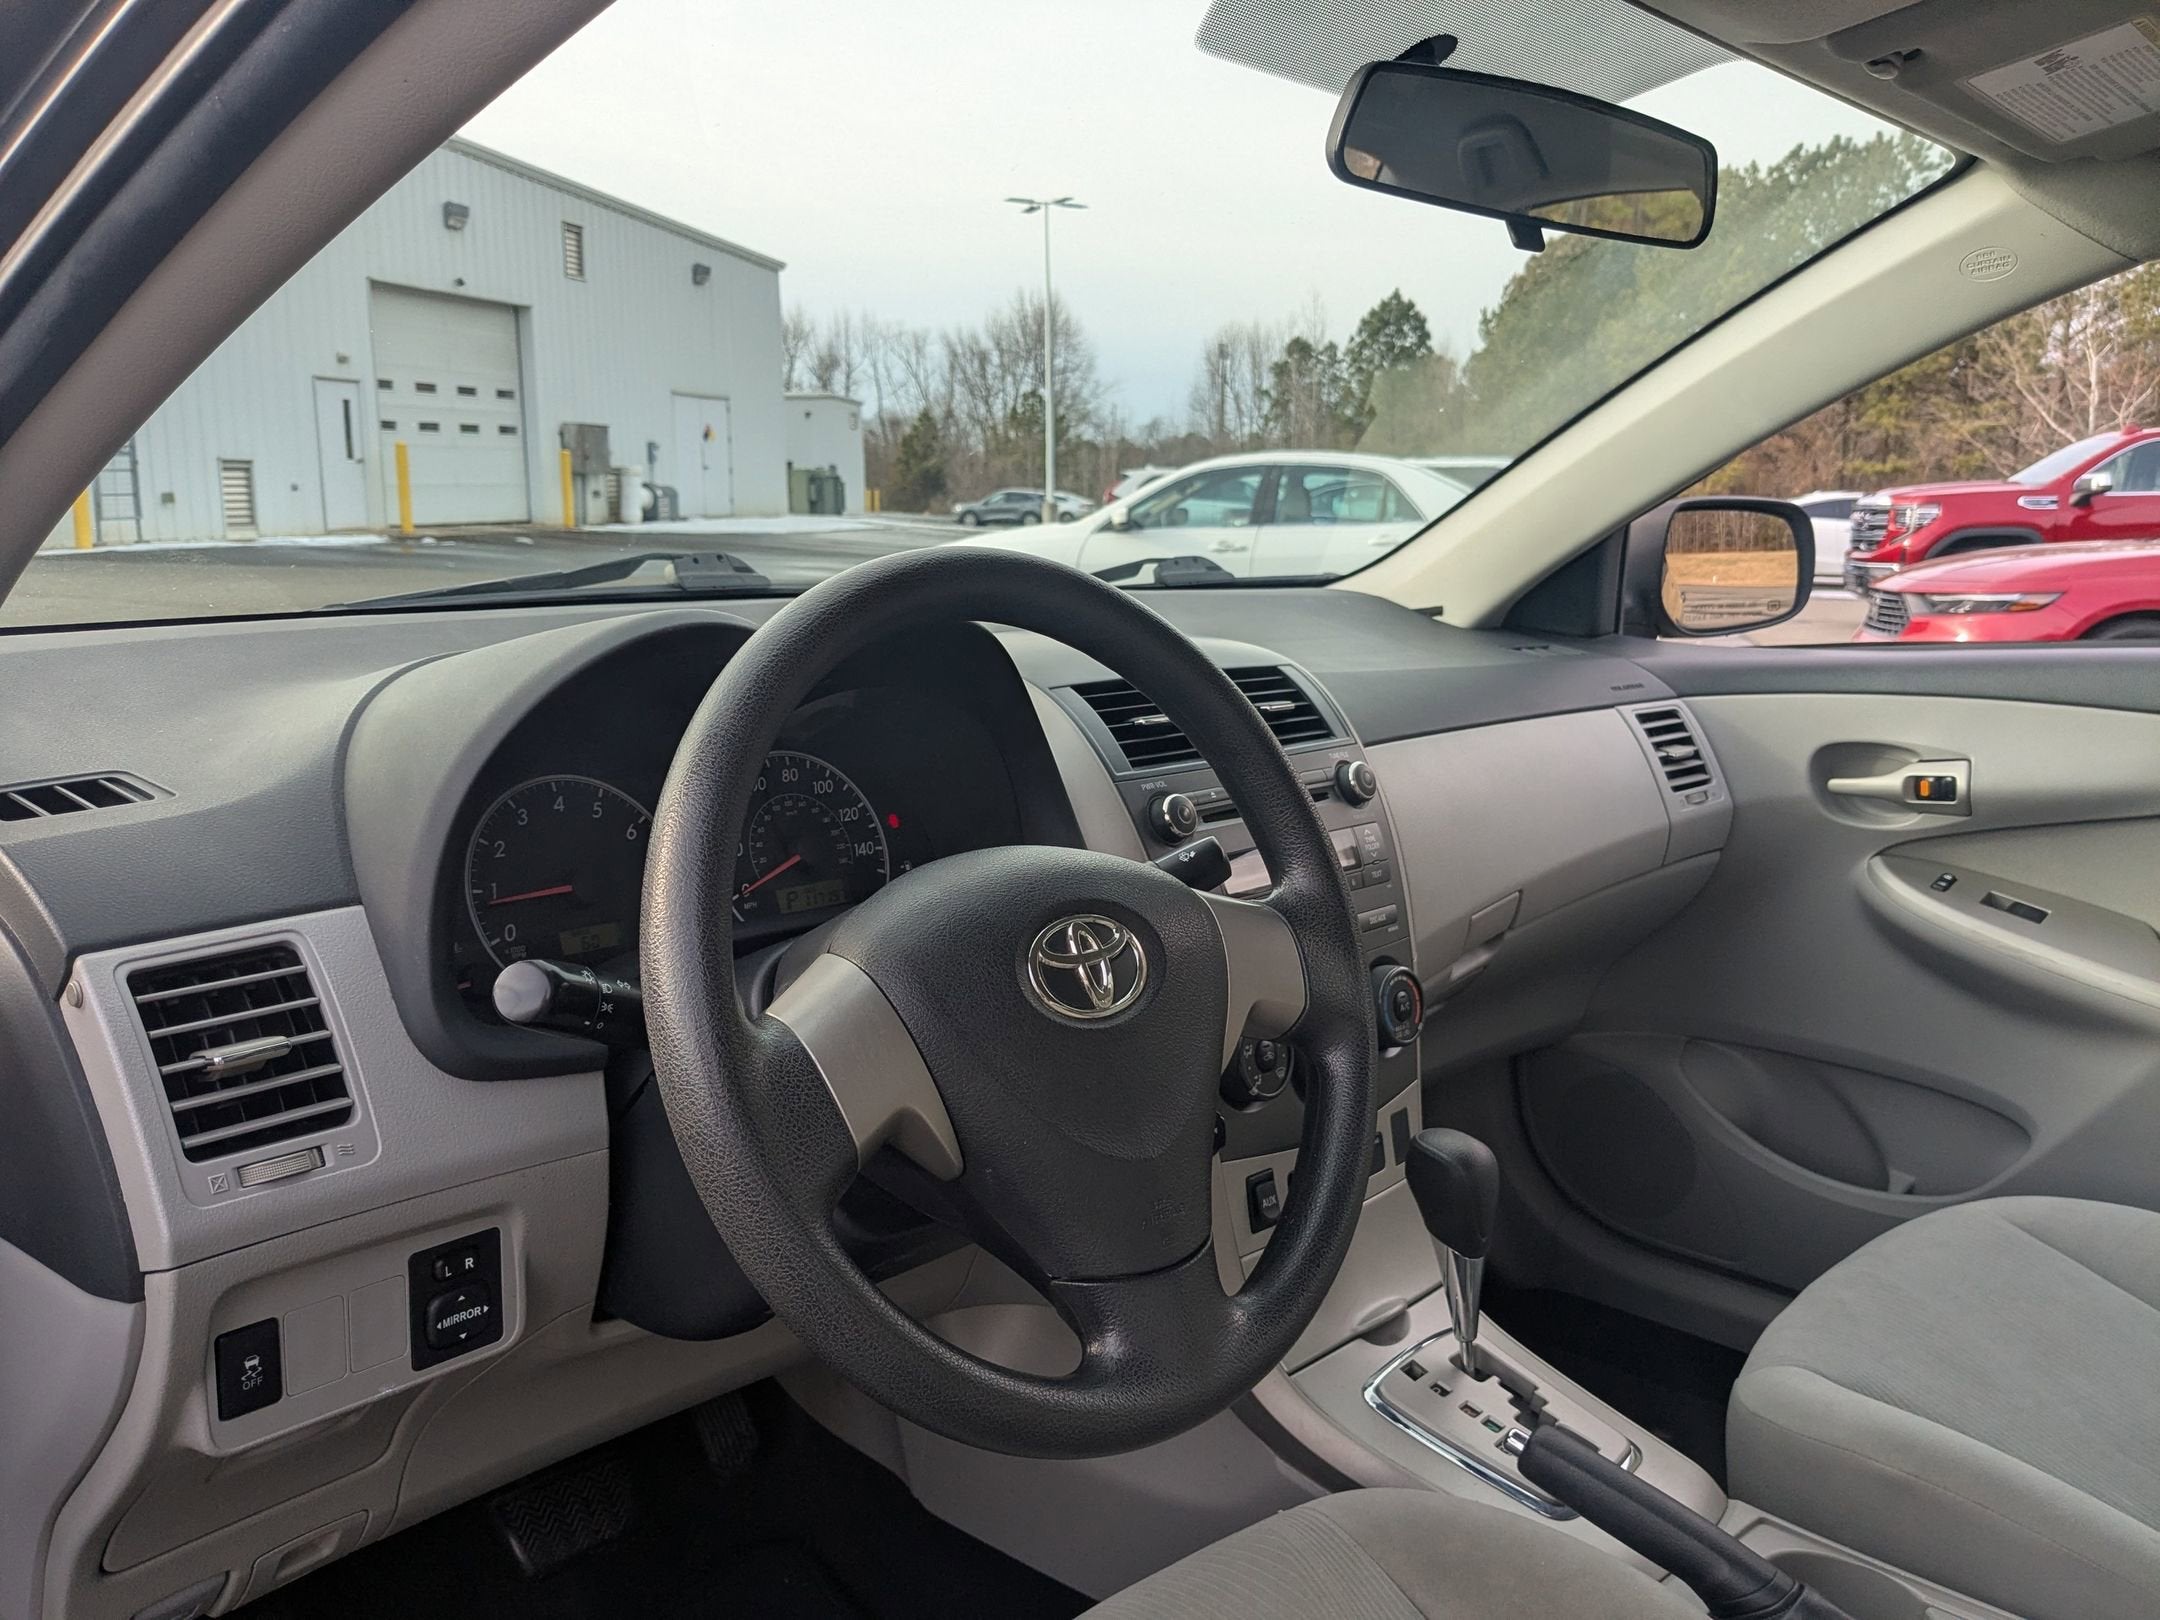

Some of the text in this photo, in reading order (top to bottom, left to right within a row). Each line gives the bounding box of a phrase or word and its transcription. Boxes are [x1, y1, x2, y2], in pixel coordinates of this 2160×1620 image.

[782, 768, 799, 782] 80
[813, 780, 834, 794] 100
[553, 795, 565, 812] 4
[591, 801, 602, 818] 5
[517, 808, 529, 825] 3
[839, 806, 859, 822] 120
[626, 823, 637, 840] 6
[494, 840, 506, 858] 2
[855, 841, 874, 856] 140
[490, 882, 497, 900] 1
[743, 901, 757, 909] MPH
[504, 924, 516, 942] 0
[1262, 1196, 1277, 1209] AUX
[445, 1257, 475, 1277] L R
[442, 1306, 482, 1329] MIRROR
[242, 1376, 263, 1391] OFF
